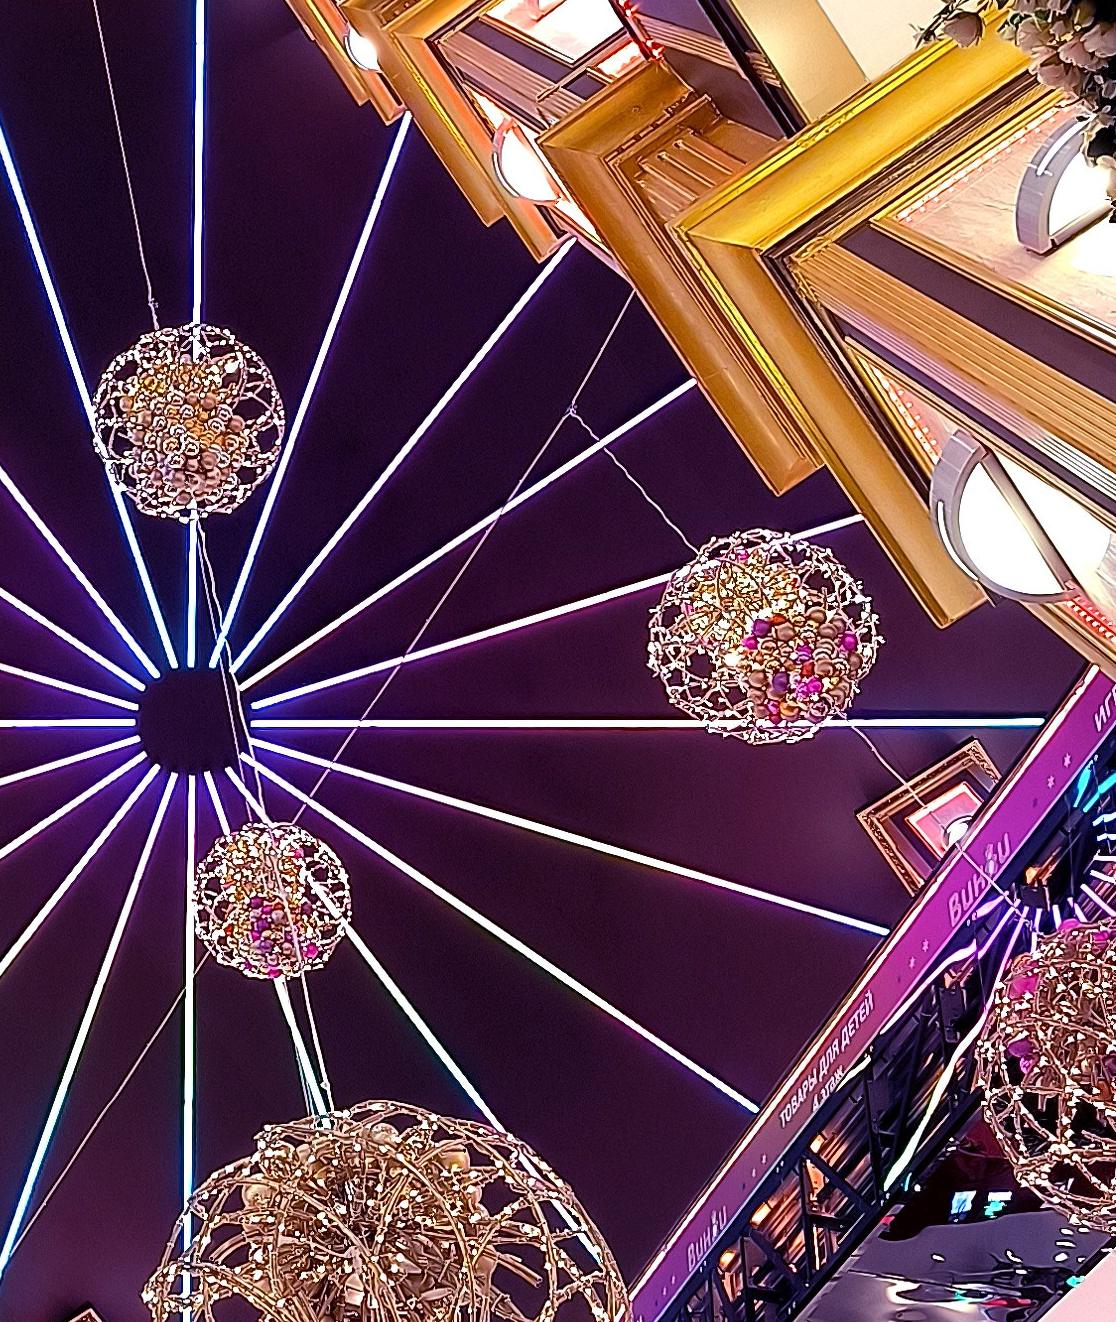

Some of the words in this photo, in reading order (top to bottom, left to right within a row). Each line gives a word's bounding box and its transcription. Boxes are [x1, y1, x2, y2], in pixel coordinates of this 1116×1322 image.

[779, 1068, 818, 1129] ТОВАРЫ
[819, 1038, 840, 1083] ДЛЯ
[841, 989, 875, 1053] ДЕТЕЙ
[812, 1093, 821, 1113] 4
[820, 1064, 846, 1106] этаж
